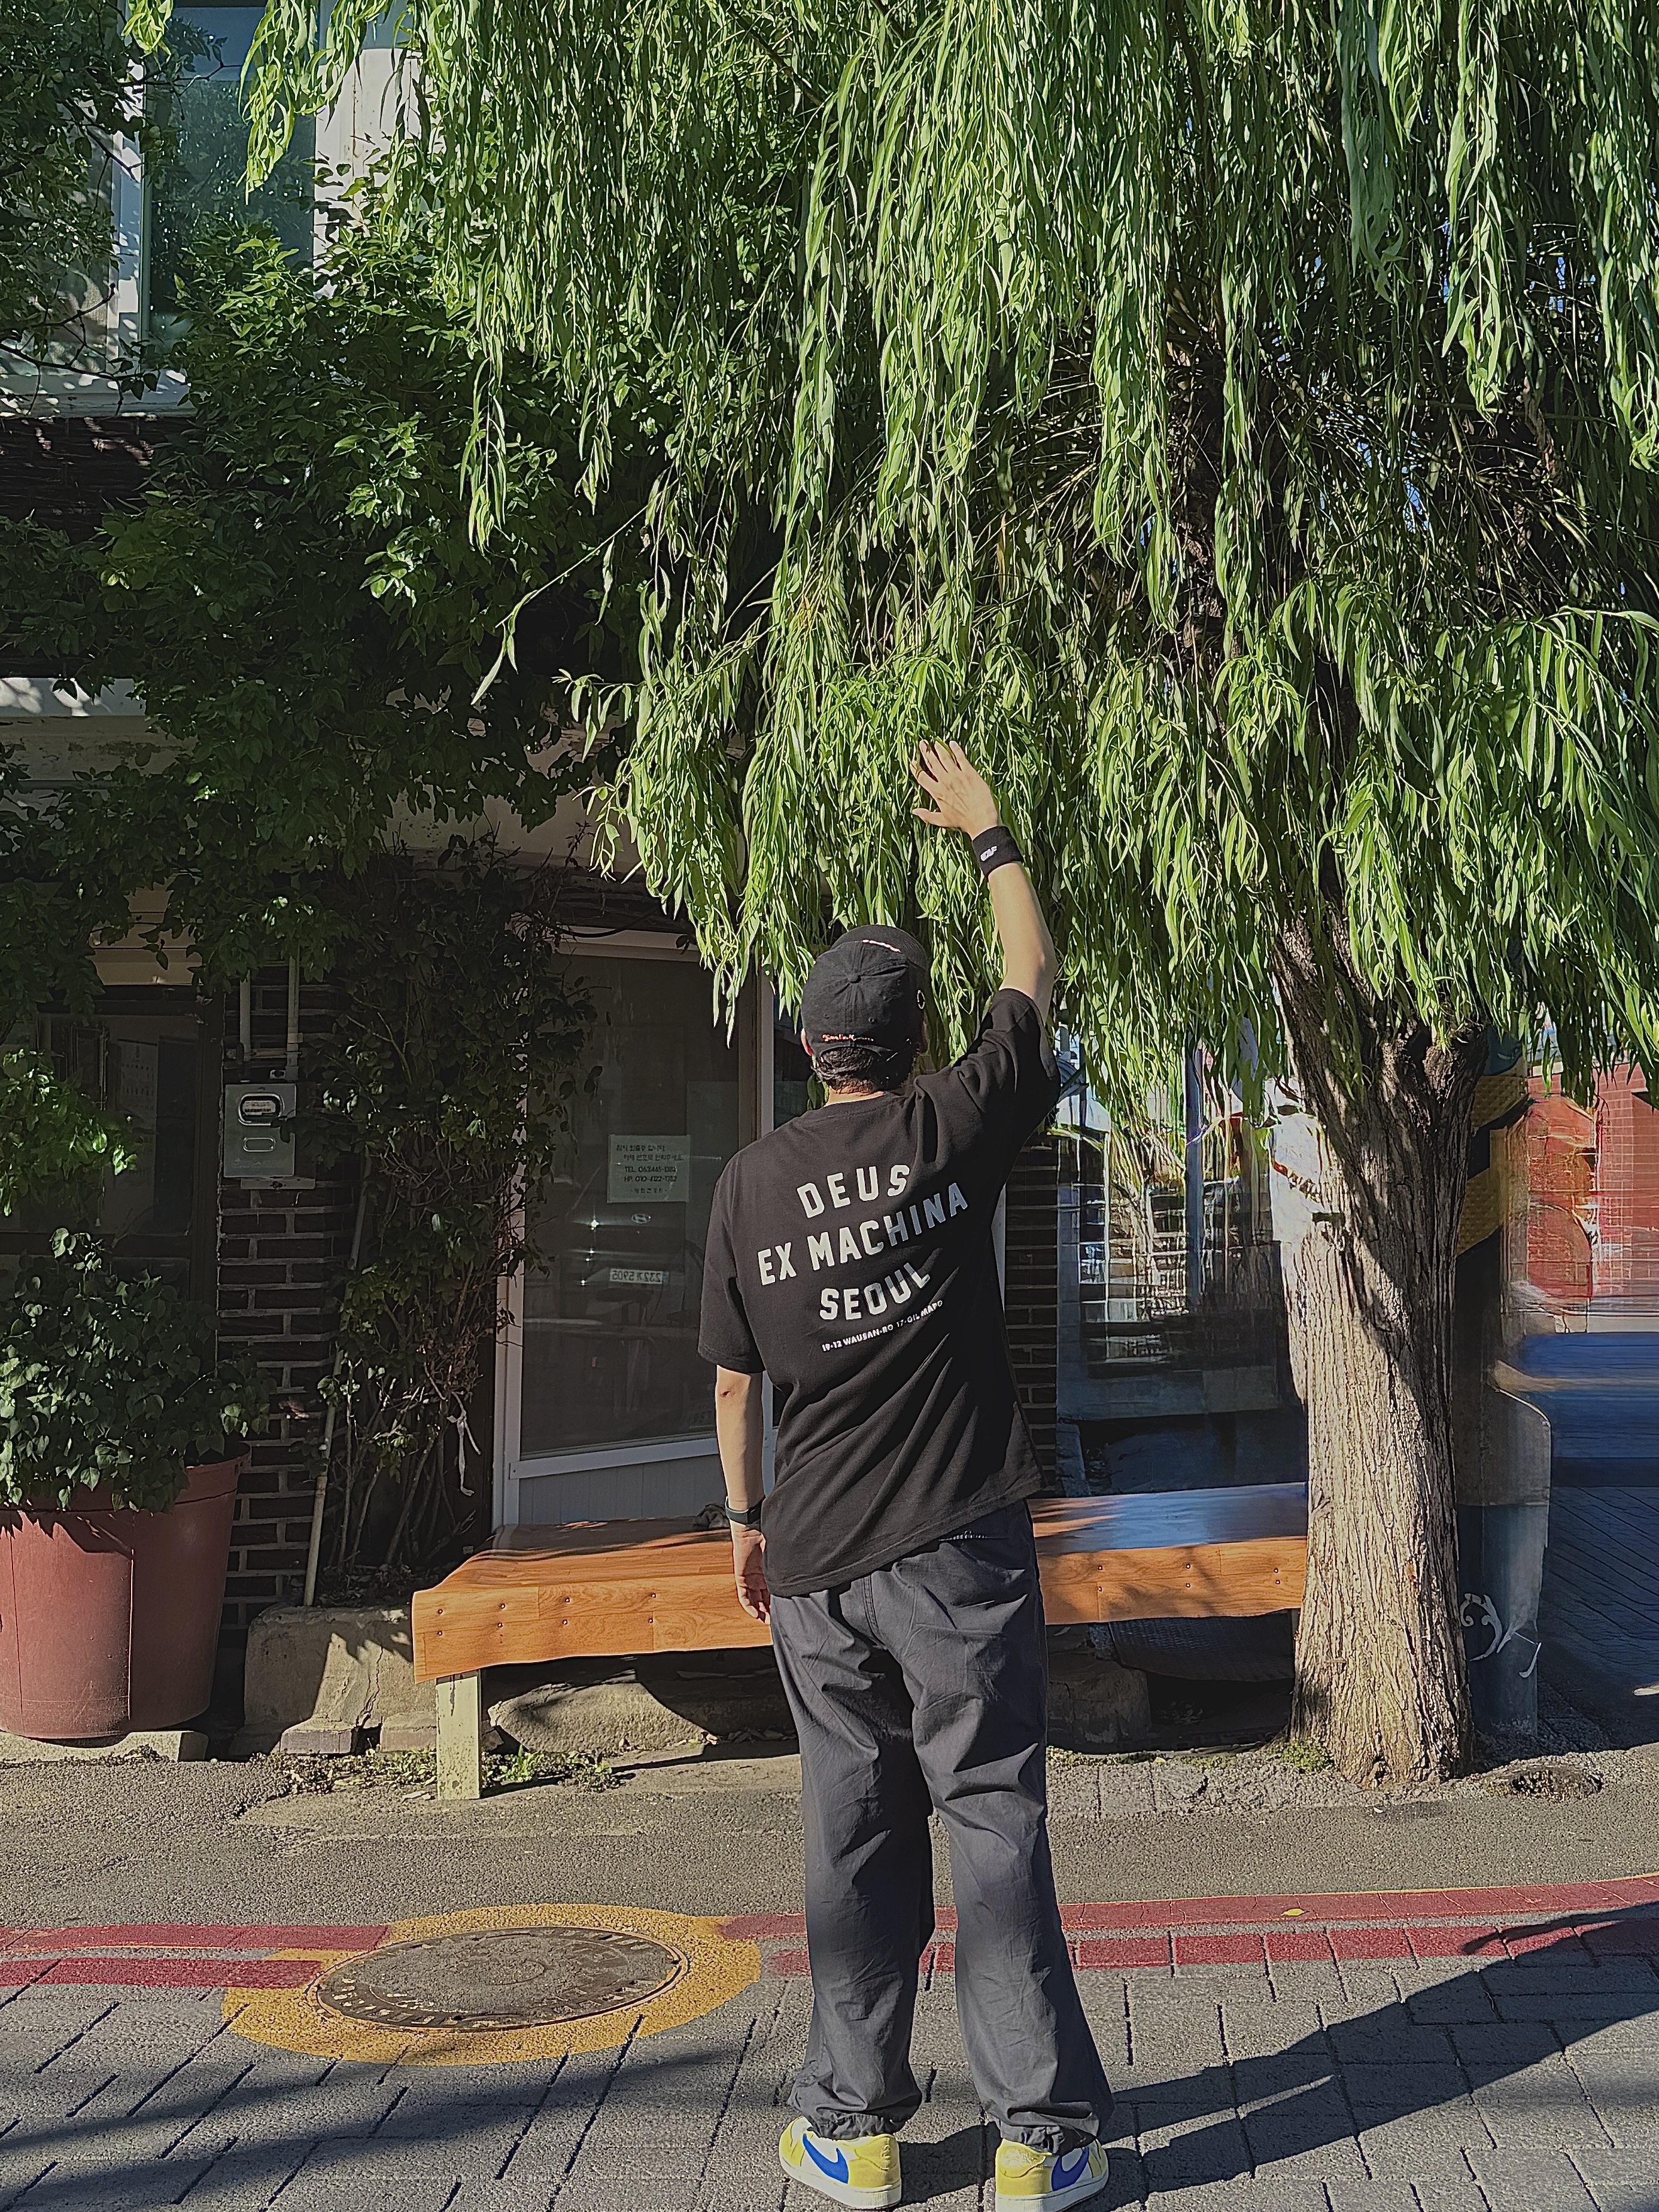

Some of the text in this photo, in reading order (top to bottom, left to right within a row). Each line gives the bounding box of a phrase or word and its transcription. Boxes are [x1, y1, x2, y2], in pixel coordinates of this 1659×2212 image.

[796, 1164, 910, 1218] DEUS
[757, 1182, 968, 1286] EX MACHINA
[819, 1262, 931, 1320] SEOUL
[920, 1300, 943, 1317] MAPO
